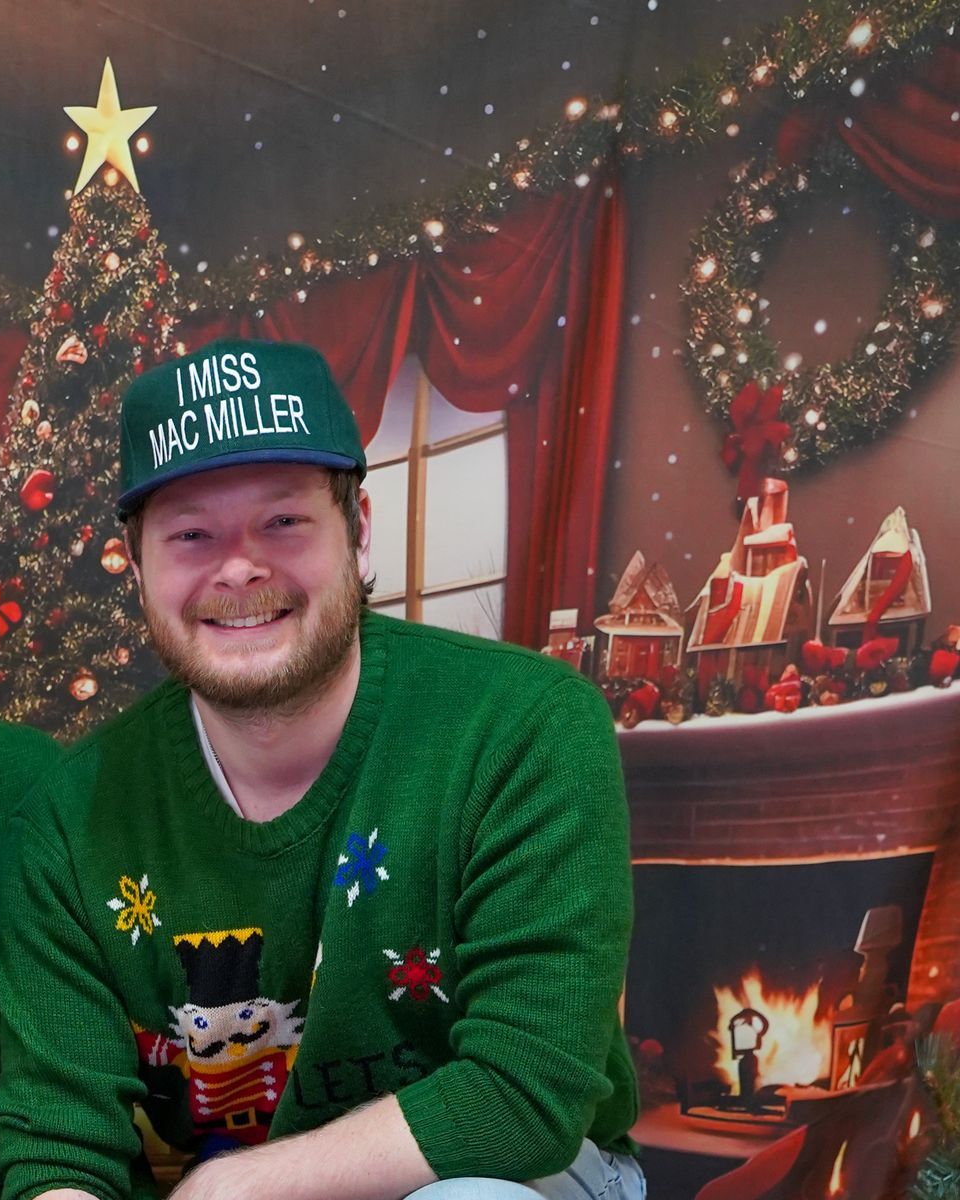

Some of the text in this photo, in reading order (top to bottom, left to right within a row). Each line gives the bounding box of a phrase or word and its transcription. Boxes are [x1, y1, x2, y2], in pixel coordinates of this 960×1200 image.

[176, 352, 261, 407] I MISS
[148, 394, 311, 470] MAC MILLER
